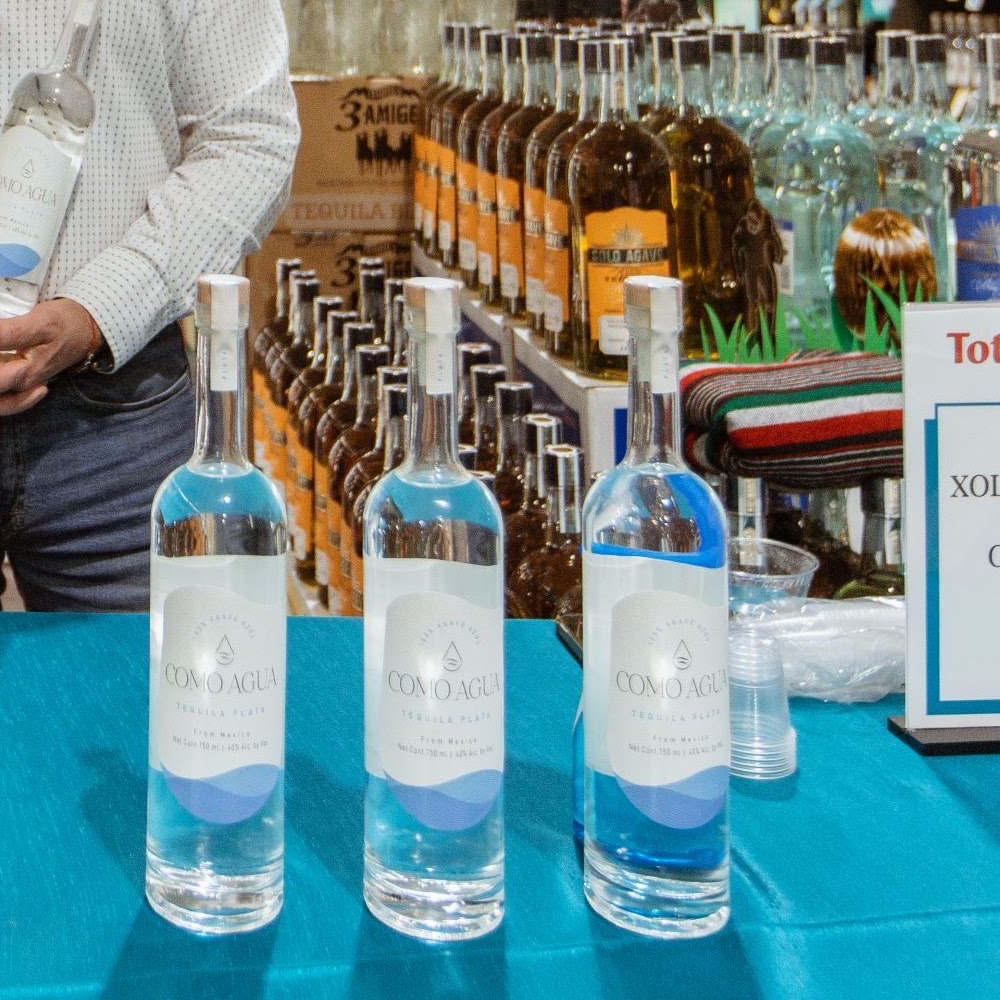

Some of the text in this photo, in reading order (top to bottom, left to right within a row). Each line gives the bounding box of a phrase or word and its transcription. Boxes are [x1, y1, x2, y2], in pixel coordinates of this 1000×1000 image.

[335, 100, 361, 131] 3
[292, 202, 384, 220] TEQUILA
[590, 247, 666, 263] SOLO AGAVE
[165, 662, 278, 694] COMO AGUA
[388, 670, 500, 701] COMO AGUA
[616, 667, 727, 700] COMO AGUA
[176, 701, 265, 717] TEQUILA PLATA
[402, 709, 490, 724] TEQUILA PLATA
[632, 708, 720, 722] TEQUILA PLATA
